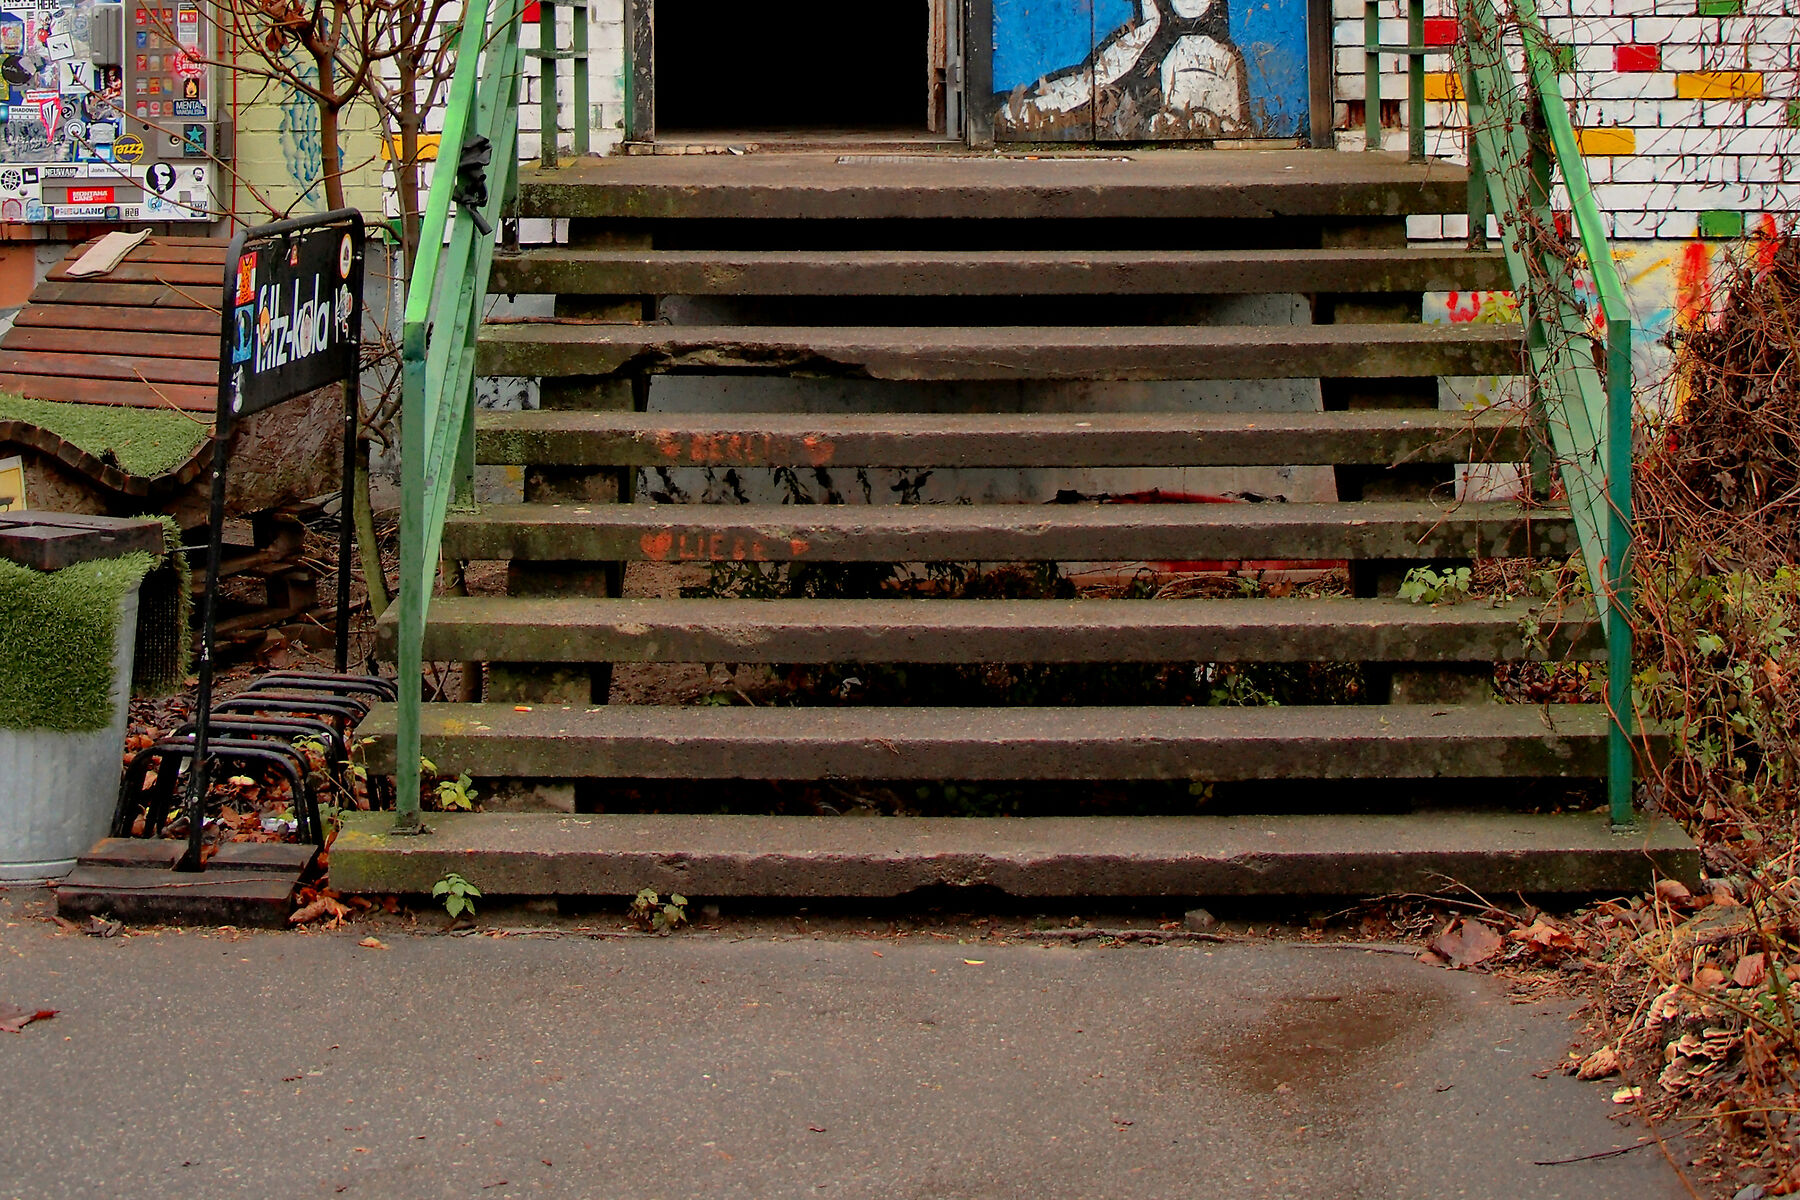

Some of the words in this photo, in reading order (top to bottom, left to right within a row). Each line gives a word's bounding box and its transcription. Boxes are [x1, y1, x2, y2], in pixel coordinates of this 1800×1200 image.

[37, 0, 60, 10] HERE
[176, 101, 203, 110] MENTAL
[72, 190, 108, 198] MONTANA
[255, 272, 331, 375] fitz-kla
